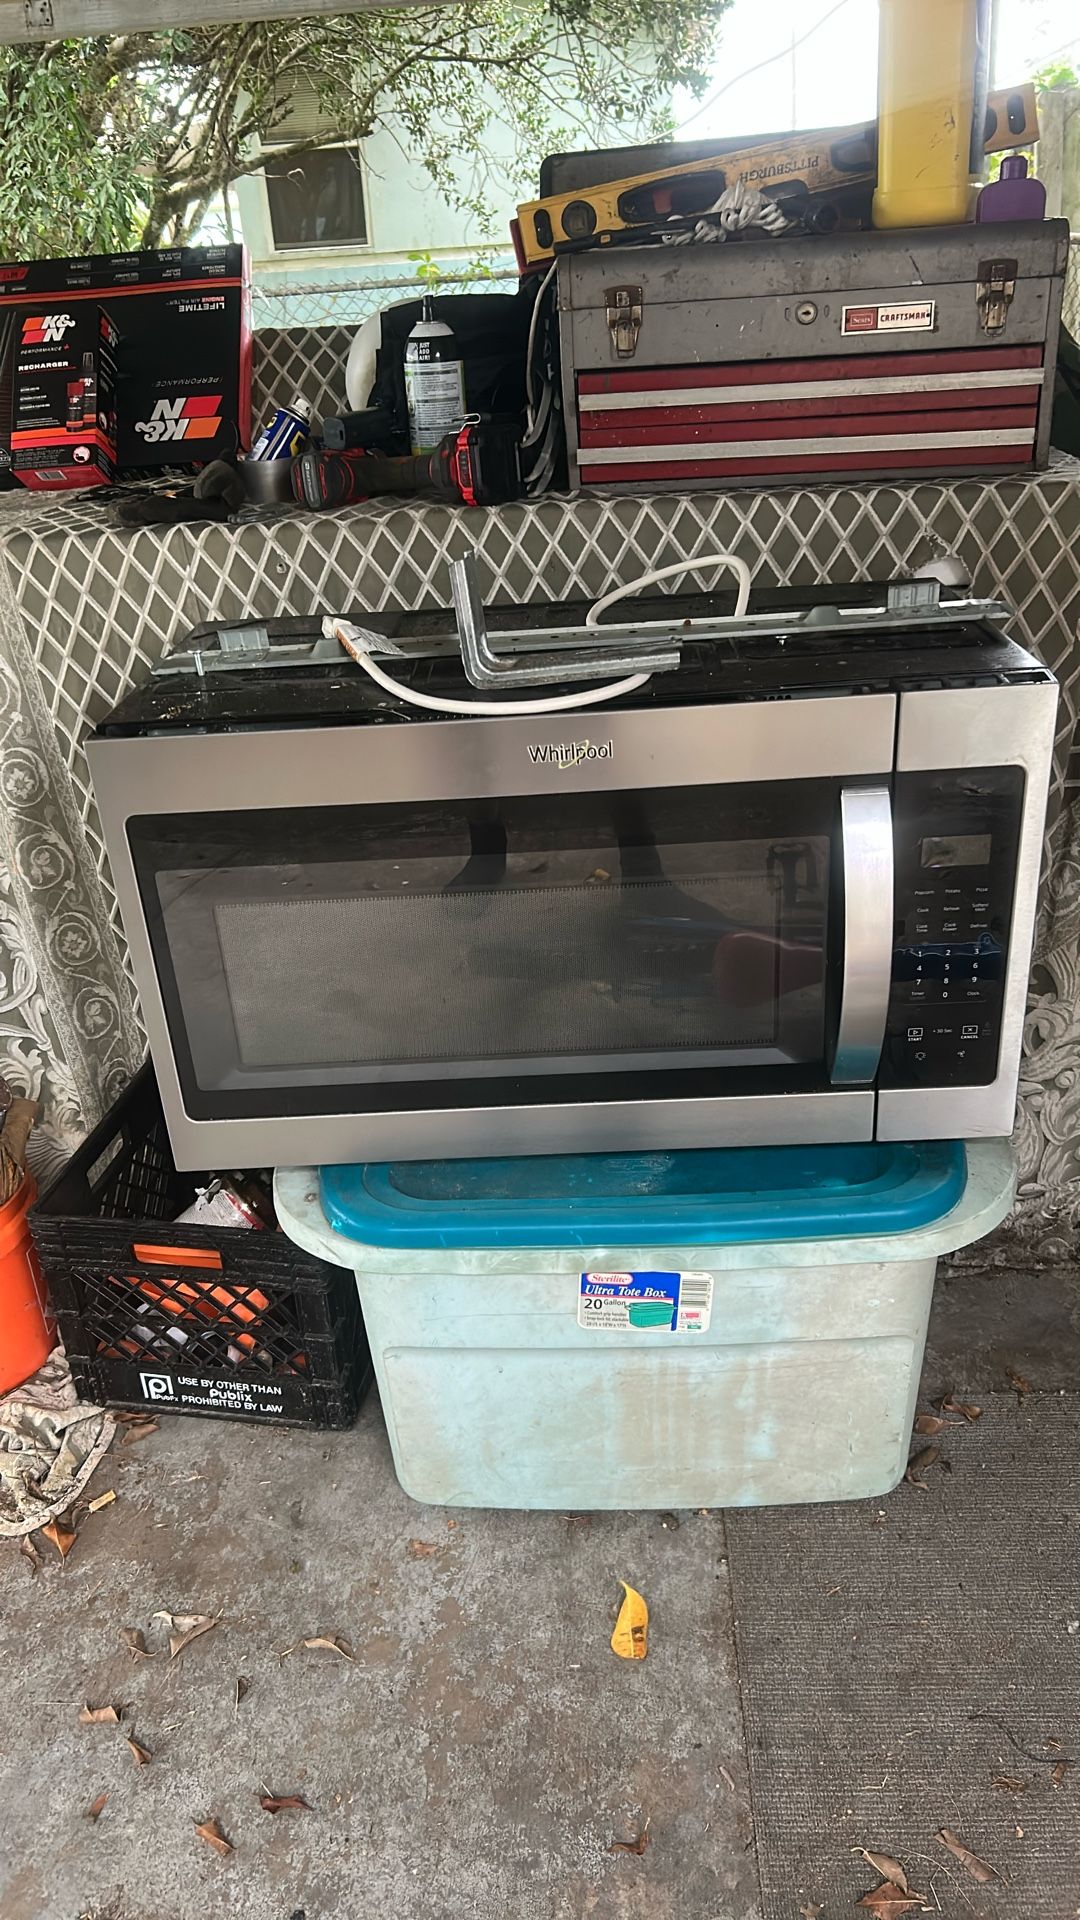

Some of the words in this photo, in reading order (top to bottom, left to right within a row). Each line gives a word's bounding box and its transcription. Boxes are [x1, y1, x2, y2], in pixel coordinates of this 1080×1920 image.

[739, 155, 819, 183] PITTSBURGH
[178, 302, 225, 313] LIFETIME
[880, 311, 926, 322] CRAFTSMAN
[18, 361, 69, 372] RECHARGER
[155, 377, 221, 388] PERFORMANCE
[527, 739, 614, 767] Whirlpool
[591, 1273, 628, 1283] Sterilite
[585, 1284, 615, 1295] Ultra
[618, 1286, 641, 1297] Tote
[643, 1287, 667, 1298] Box
[584, 1298, 602, 1310] 20
[177, 1376, 199, 1387] USE
[201, 1379, 214, 1389] BY
[216, 1380, 250, 1393] OTHER
[250, 1384, 282, 1395] THAN
[209, 1388, 253, 1402] Publix
[181, 1394, 241, 1409] PROHIBITED
[244, 1402, 258, 1411] BY
[259, 1403, 283, 1414] LAW
